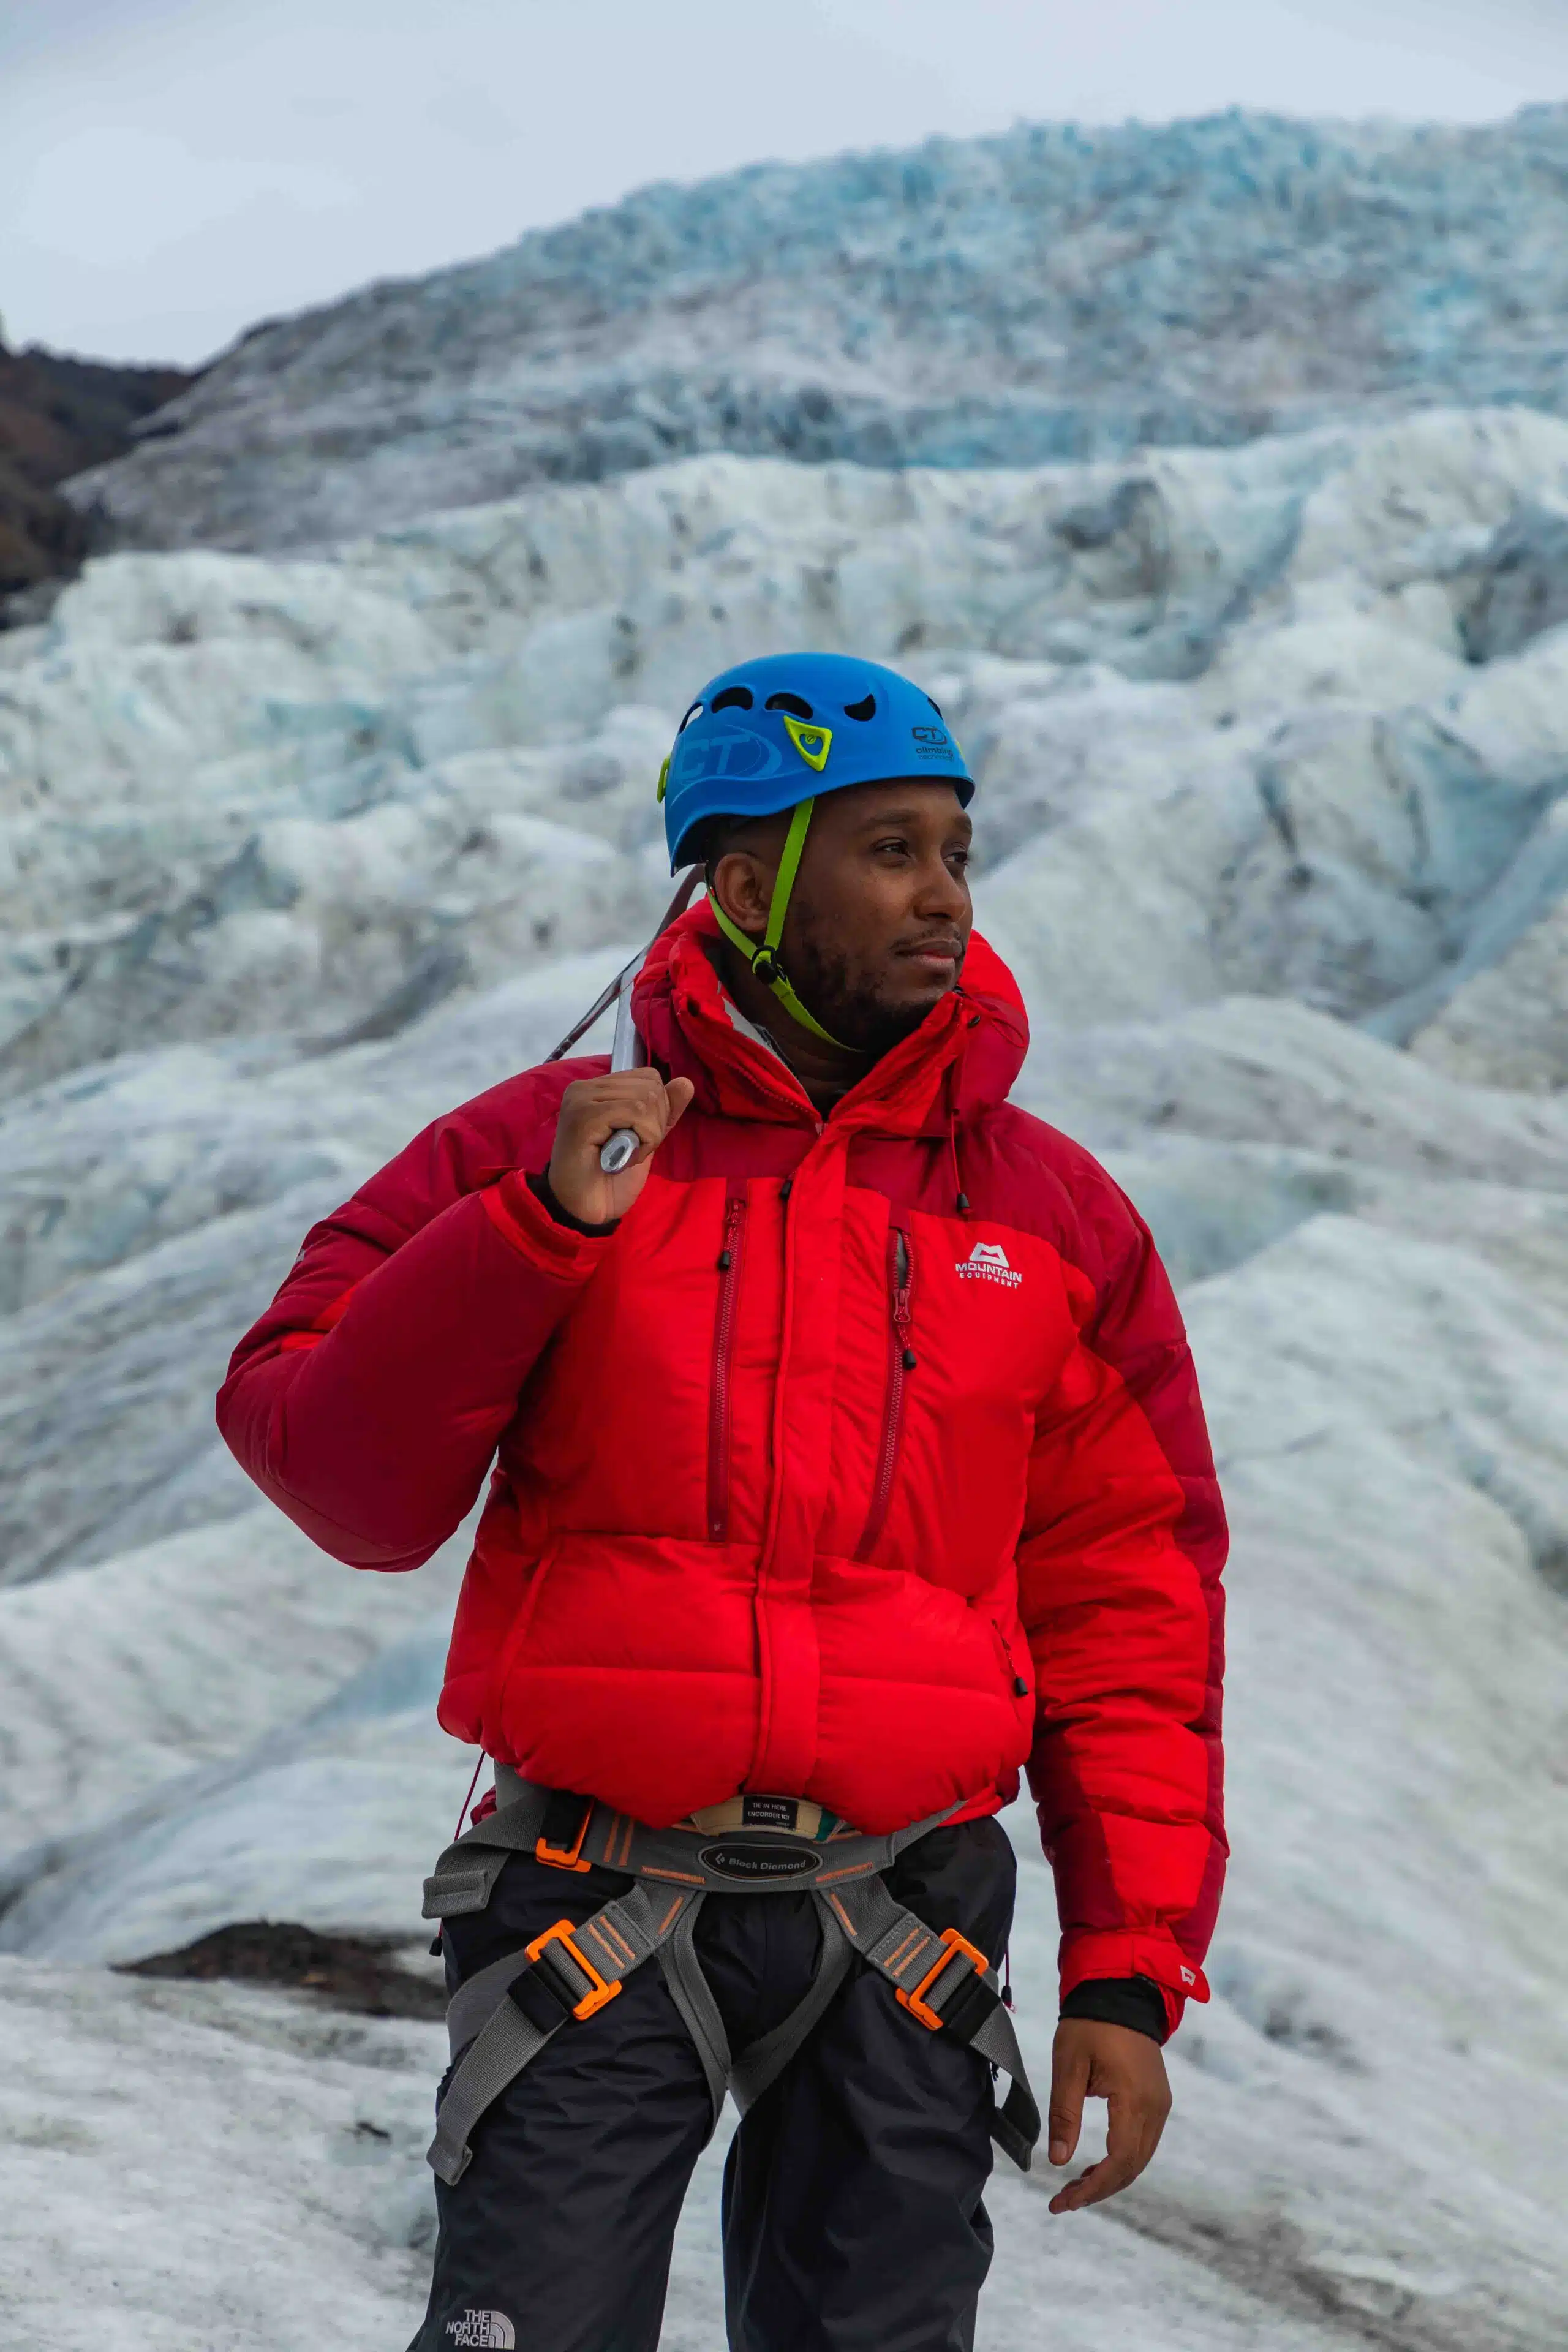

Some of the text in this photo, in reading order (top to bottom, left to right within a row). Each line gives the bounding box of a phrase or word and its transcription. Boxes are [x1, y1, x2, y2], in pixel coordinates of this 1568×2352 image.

[916, 747, 953, 758] climbing
[956, 1262, 1022, 1283] MOUNTAIN
[959, 1272, 1019, 1289] EQUIPMENT
[729, 1858, 806, 1870] Black Diamond
[464, 2309, 491, 2323] THE
[445, 2321, 490, 2335] NORTH
[454, 2334, 488, 2347] FACE
